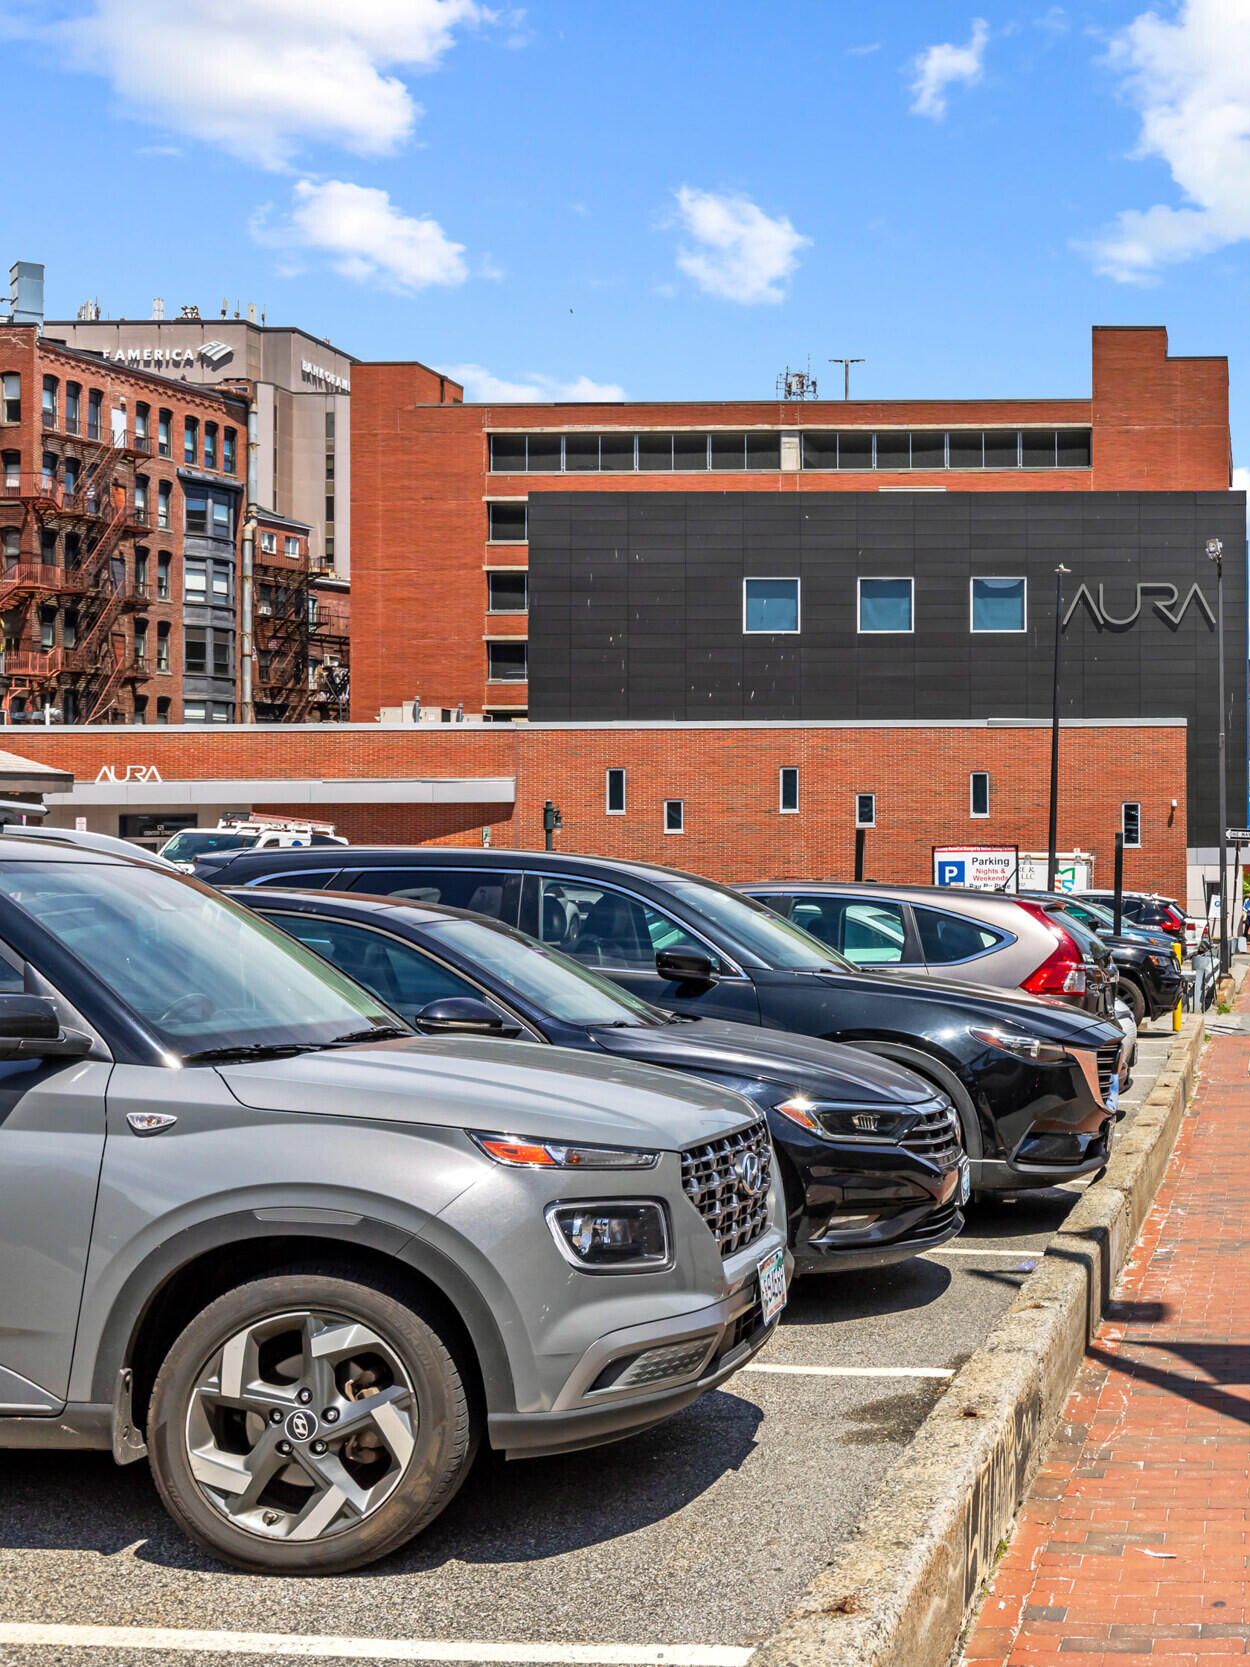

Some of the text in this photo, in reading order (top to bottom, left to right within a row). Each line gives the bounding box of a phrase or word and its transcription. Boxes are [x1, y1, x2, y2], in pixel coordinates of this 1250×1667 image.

[115, 349, 194, 360] AMERICA
[1063, 582, 1216, 625] AURA
[94, 765, 163, 783] AURA
[971, 857, 1010, 867] Parking
